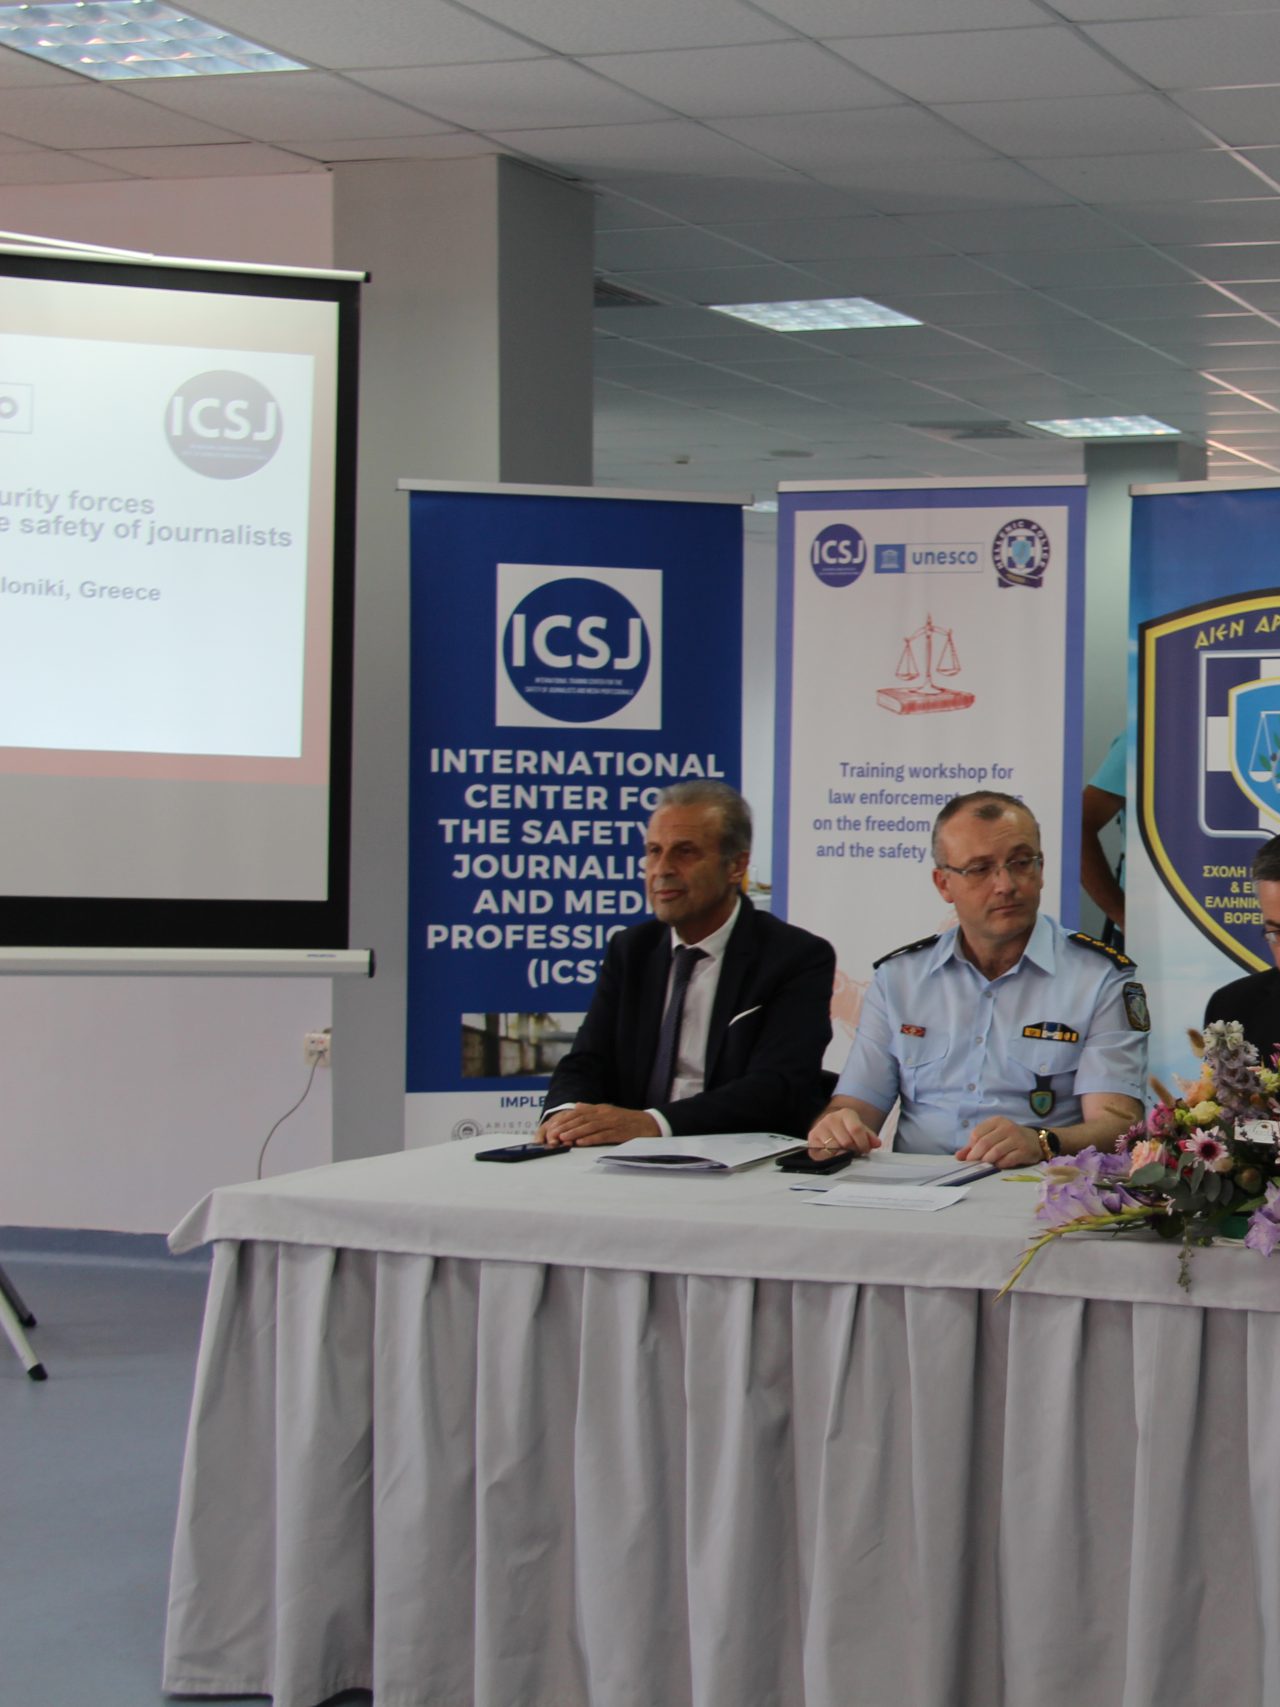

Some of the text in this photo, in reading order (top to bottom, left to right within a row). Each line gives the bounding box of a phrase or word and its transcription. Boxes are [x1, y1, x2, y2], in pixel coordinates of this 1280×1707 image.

[171, 395, 279, 441] ICSJ
[68, 490, 156, 515] forces
[20, 514, 105, 542] safety
[114, 518, 142, 540] of
[147, 520, 293, 547] journalists
[813, 539, 864, 566] ICSJ
[912, 549, 979, 566] unesco
[1, 576, 162, 602] loniki, Greece
[512, 613, 642, 670] ICSJ
[430, 747, 725, 778] INTERNATIONAL
[840, 762, 1014, 784] Training workshop for
[464, 784, 608, 810] CENTER
[828, 789, 855, 805] law
[439, 819, 511, 844] THE
[813, 816, 931, 833] on the freedom
[816, 842, 927, 863] and the safety
[1202, 865, 1247, 878] ΣΧΟΛΗ
[1230, 881, 1240, 894] &
[473, 889, 553, 915] AND
[528, 957, 604, 988] (ICS
